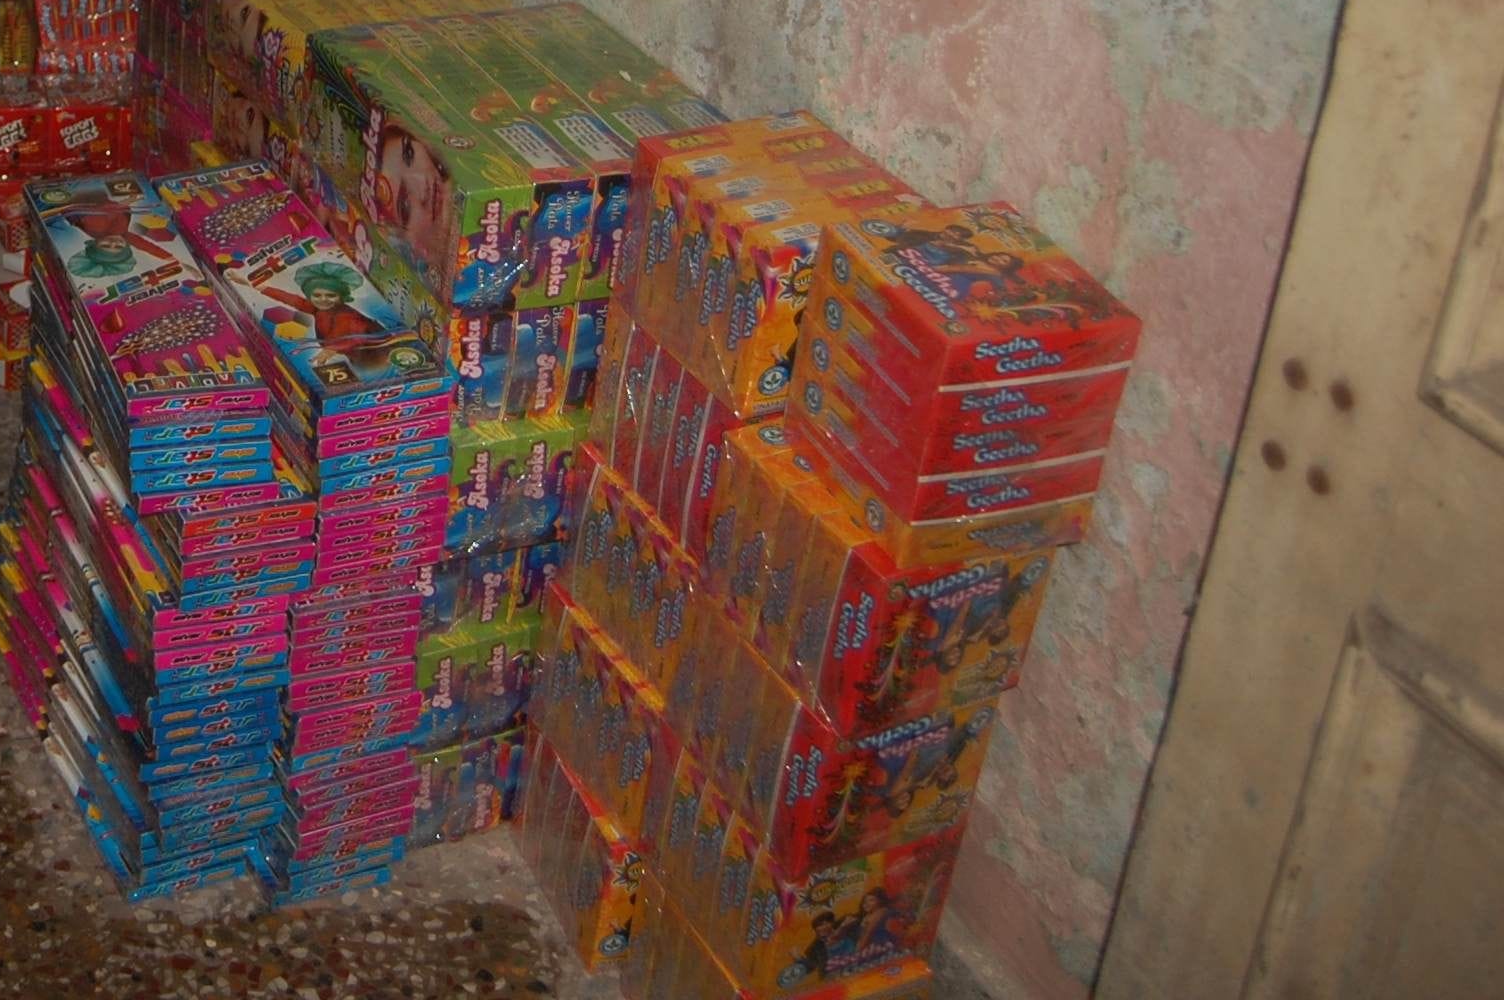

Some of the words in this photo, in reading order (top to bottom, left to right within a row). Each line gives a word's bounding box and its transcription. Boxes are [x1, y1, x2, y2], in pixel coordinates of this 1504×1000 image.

[247, 234, 293, 267] silver
[477, 199, 501, 263] Asoka
[99, 259, 184, 305] star
[247, 236, 319, 288] star
[547, 235, 571, 297] Asoka
[898, 248, 959, 299] Seetha
[126, 279, 181, 306] silver
[744, 277, 761, 337] Seetha
[894, 265, 955, 320] Geetha
[727, 292, 745, 350] Geetha
[460, 318, 483, 378] Asoka
[975, 336, 1041, 360] Seetha
[996, 350, 1063, 373] Geetha
[325, 367, 348, 383] 75
[960, 388, 1025, 411] Seetha
[982, 404, 1048, 425] Geetha
[700, 444, 716, 497] Geetha
[973, 442, 1038, 463] Geetha
[467, 450, 490, 510] Asoka
[967, 486, 1030, 509] Geetha
[833, 602, 854, 659] Geetha
[852, 592, 874, 648] Seetha
[432, 657, 453, 709] Asoka
